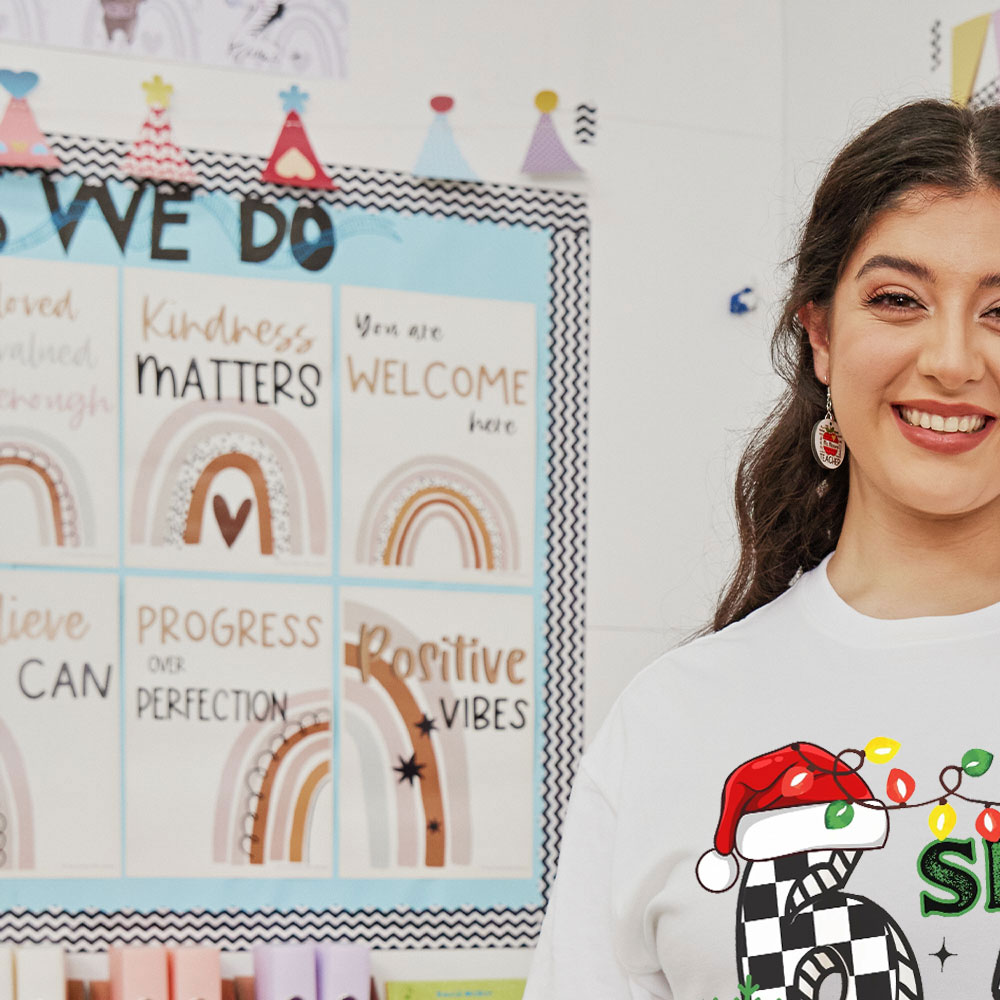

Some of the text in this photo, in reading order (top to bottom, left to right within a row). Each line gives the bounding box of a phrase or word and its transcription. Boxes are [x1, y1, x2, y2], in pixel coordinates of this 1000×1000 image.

[41, 174, 195, 262] WE
[240, 198, 336, 272] DO
[140, 294, 319, 354] Kindness
[136, 354, 321, 407] MATTERS
[347, 354, 530, 406] WELCOME
[469, 411, 518, 436] here
[137, 604, 323, 649] PROGRESS
[149, 655, 186, 673] OVER
[359, 623, 528, 685] Positive
[19, 658, 111, 699] CAN
[137, 686, 288, 722] PERFECTION
[440, 696, 529, 731] VIBES
